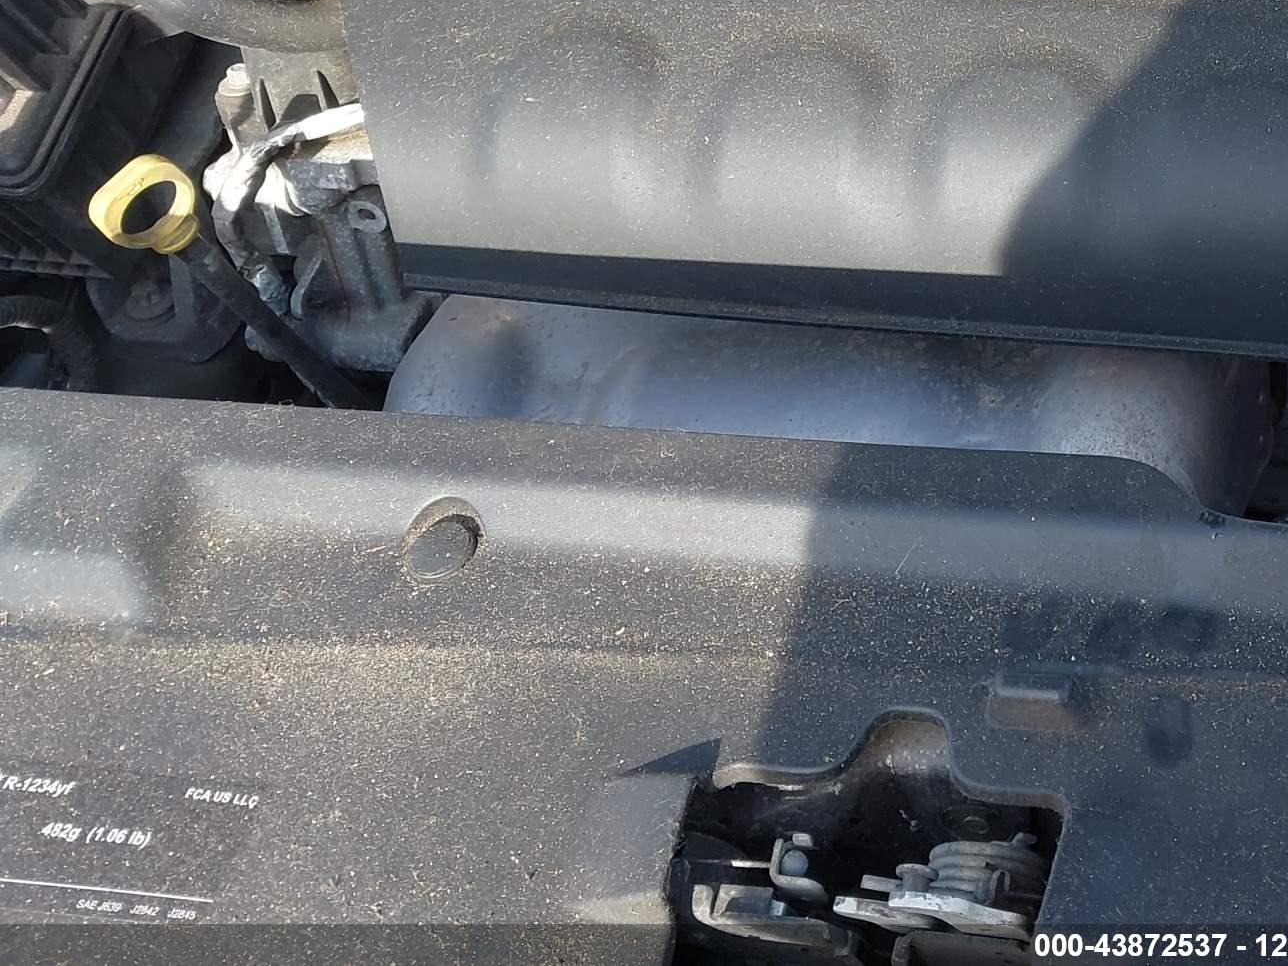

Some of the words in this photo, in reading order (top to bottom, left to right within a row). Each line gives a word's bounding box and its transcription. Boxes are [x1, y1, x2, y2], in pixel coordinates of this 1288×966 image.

[2, 775, 77, 798] R-1234yf
[185, 787, 212, 803] FCA
[213, 791, 232, 805] US
[232, 794, 260, 809] LLC
[40, 822, 82, 843] 482g
[86, 824, 127, 845] (1.06
[128, 831, 153, 851] lb)
[76, 899, 98, 910] SAE
